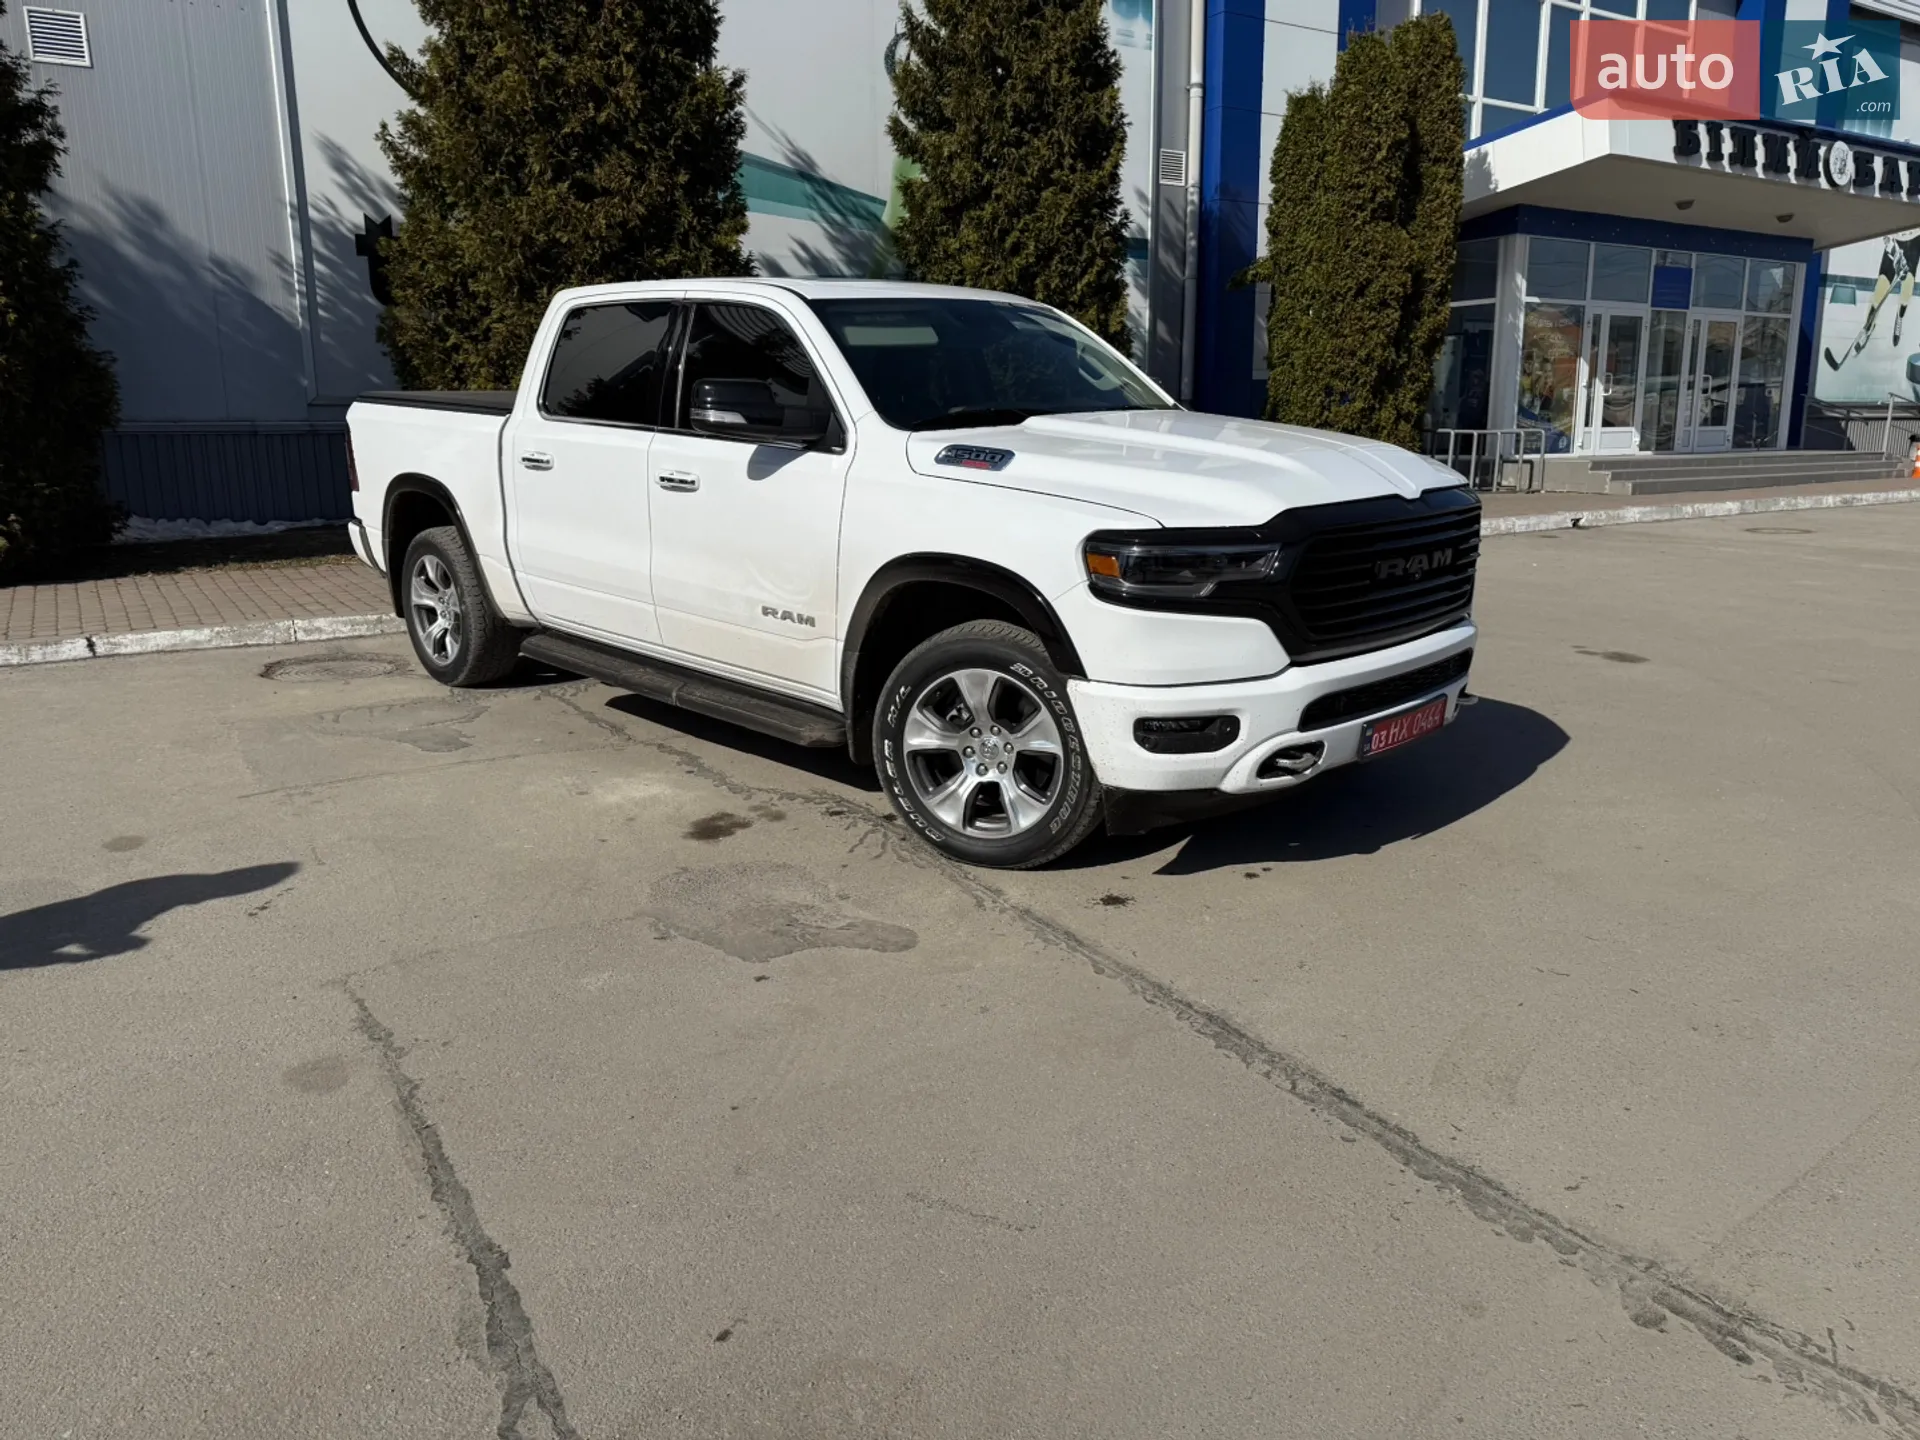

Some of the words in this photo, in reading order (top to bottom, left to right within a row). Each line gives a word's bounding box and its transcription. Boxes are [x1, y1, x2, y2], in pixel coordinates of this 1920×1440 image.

[1672, 117, 1821, 179] БІЛИЙ
[1376, 548, 1453, 579] RAM
[761, 605, 816, 628] RAM
[1371, 730, 1388, 750] 03
